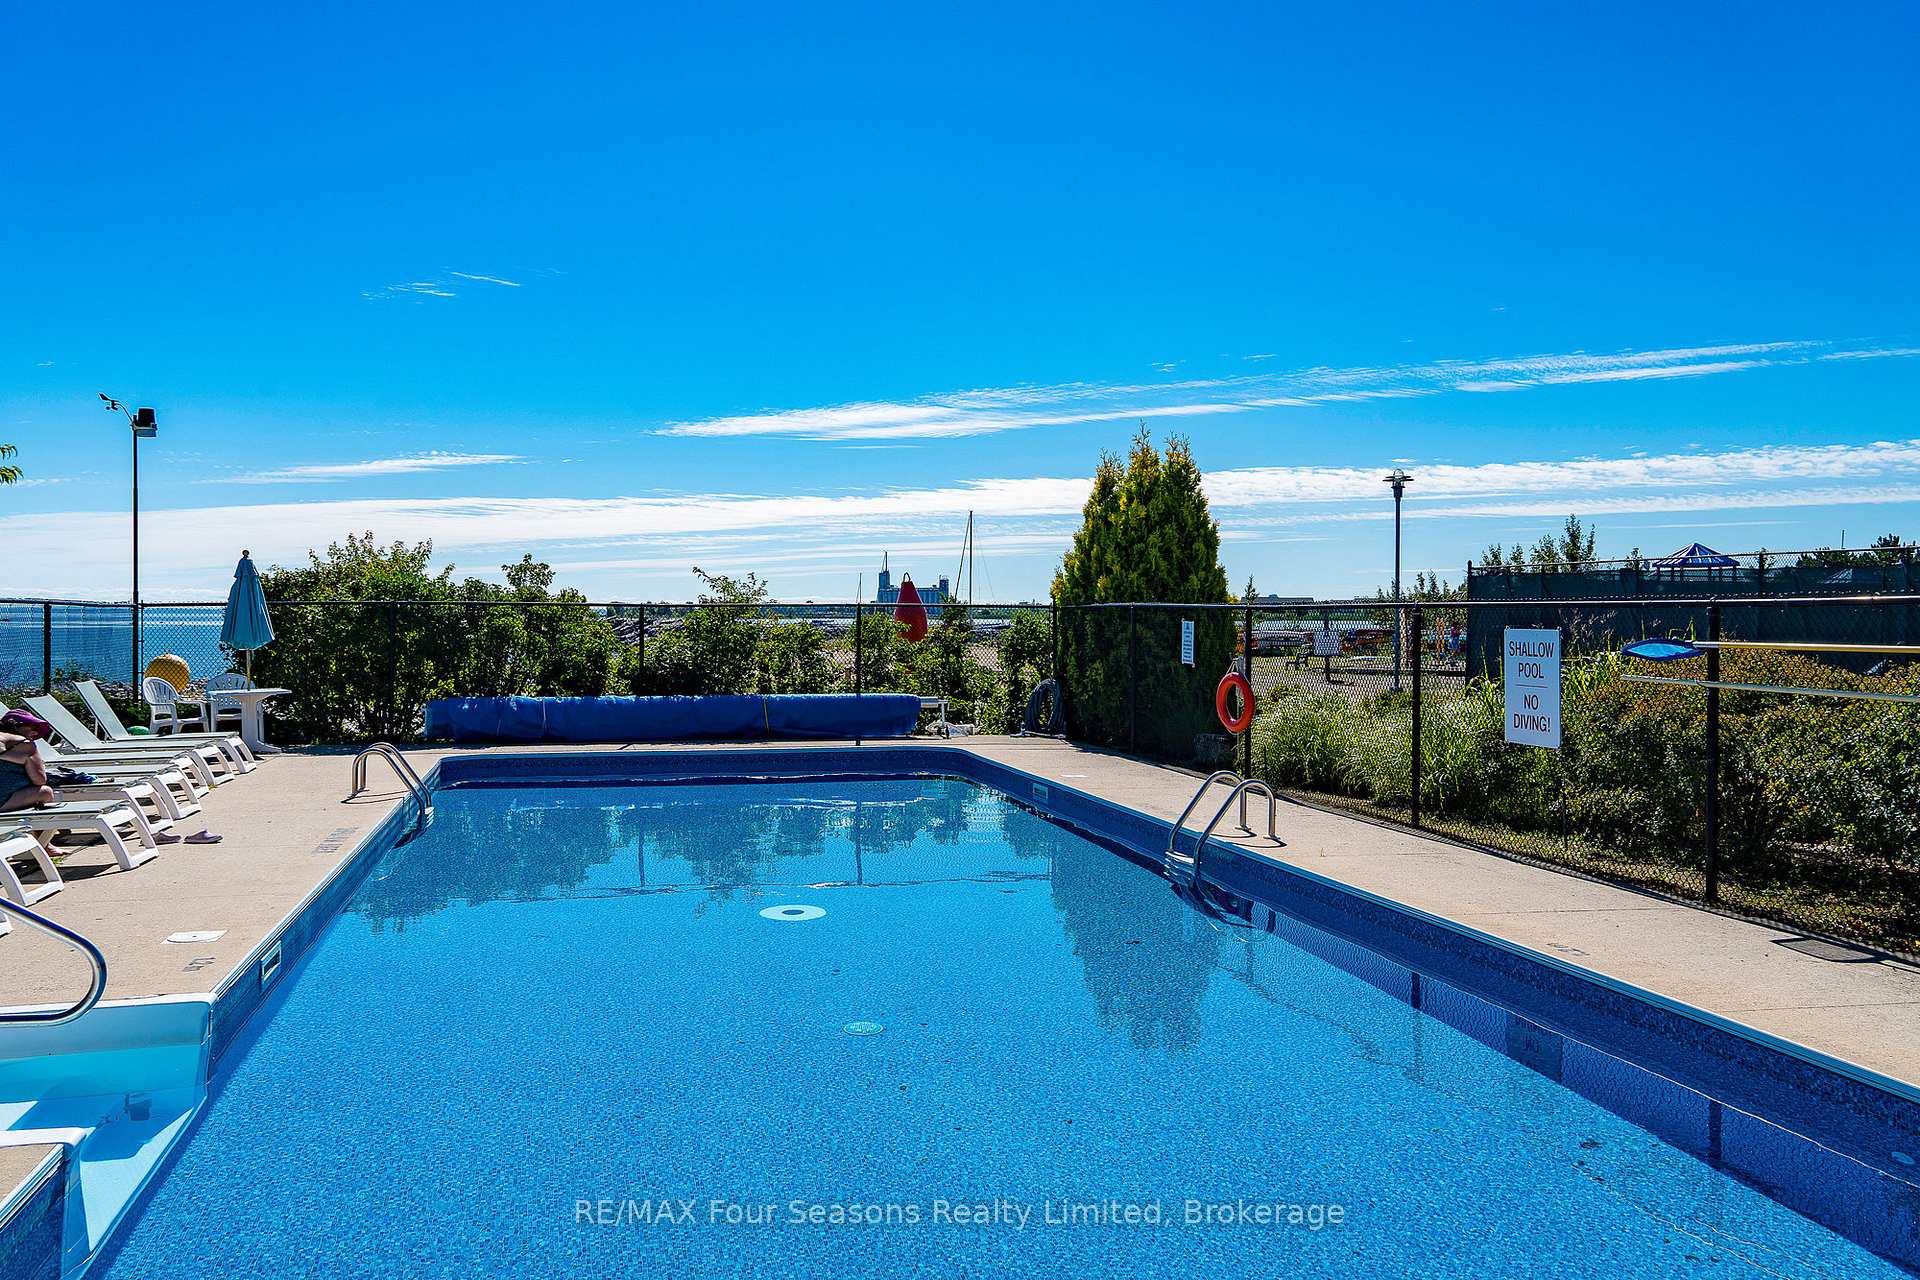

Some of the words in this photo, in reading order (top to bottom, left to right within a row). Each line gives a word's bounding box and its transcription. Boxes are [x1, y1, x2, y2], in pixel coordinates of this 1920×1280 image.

[1508, 640, 1554, 657] SHALLOW
[1518, 662, 1544, 679] POOL
[1523, 694, 1539, 710] NO
[1513, 713, 1551, 732] DIVING!
